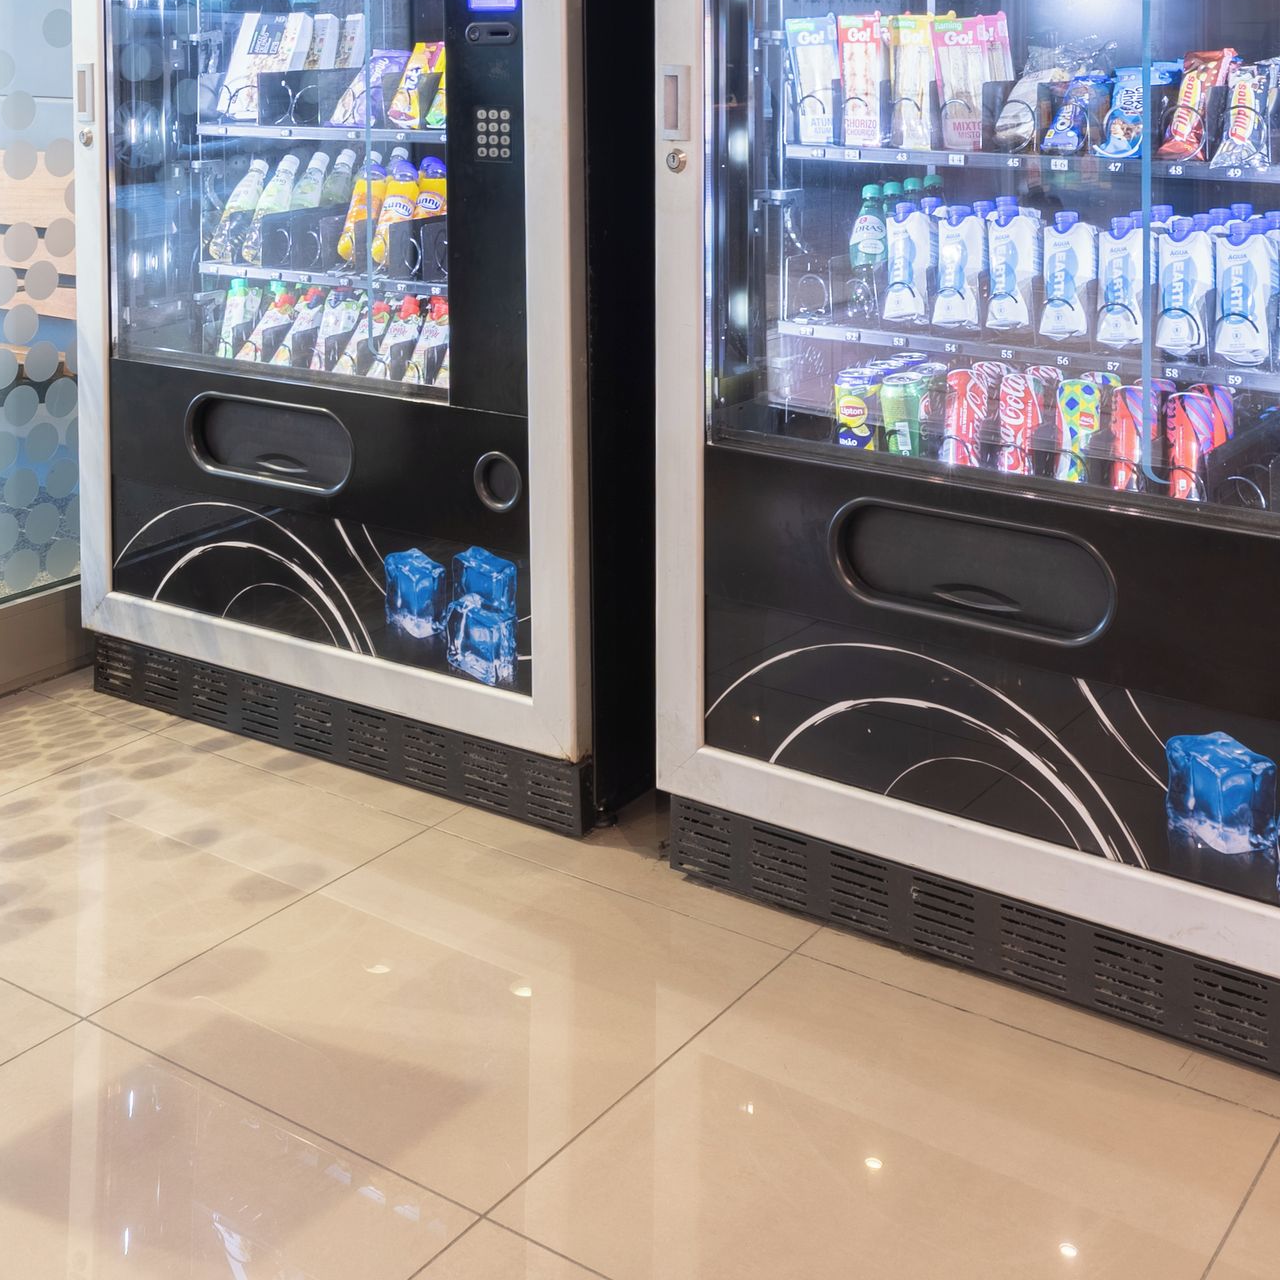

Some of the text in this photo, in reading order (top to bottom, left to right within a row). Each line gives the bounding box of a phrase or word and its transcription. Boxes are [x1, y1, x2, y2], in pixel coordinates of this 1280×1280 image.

[797, 30, 824, 44] Go!
[847, 28, 870, 42] Go!
[944, 31, 973, 45] Go!
[1172, 75, 1196, 140] Filipinos
[1230, 83, 1247, 143] Filipinos
[845, 119, 877, 129] CHORIZO
[896, 153, 907, 161] 43
[1007, 158, 1019, 167] 45
[1108, 163, 1121, 172] 47
[1169, 166, 1183, 175] 48
[1227, 168, 1242, 177] 49
[416, 195, 441, 209] unny
[855, 223, 884, 234] DRAS
[893, 337, 904, 346] 53
[945, 344, 956, 352] 54
[1001, 350, 1012, 359] 55
[1057, 356, 1069, 366] 56
[1107, 361, 1119, 370] 57
[1165, 368, 1178, 378] 58
[1228, 375, 1242, 385] 59
[839, 406, 864, 416] Lipton
